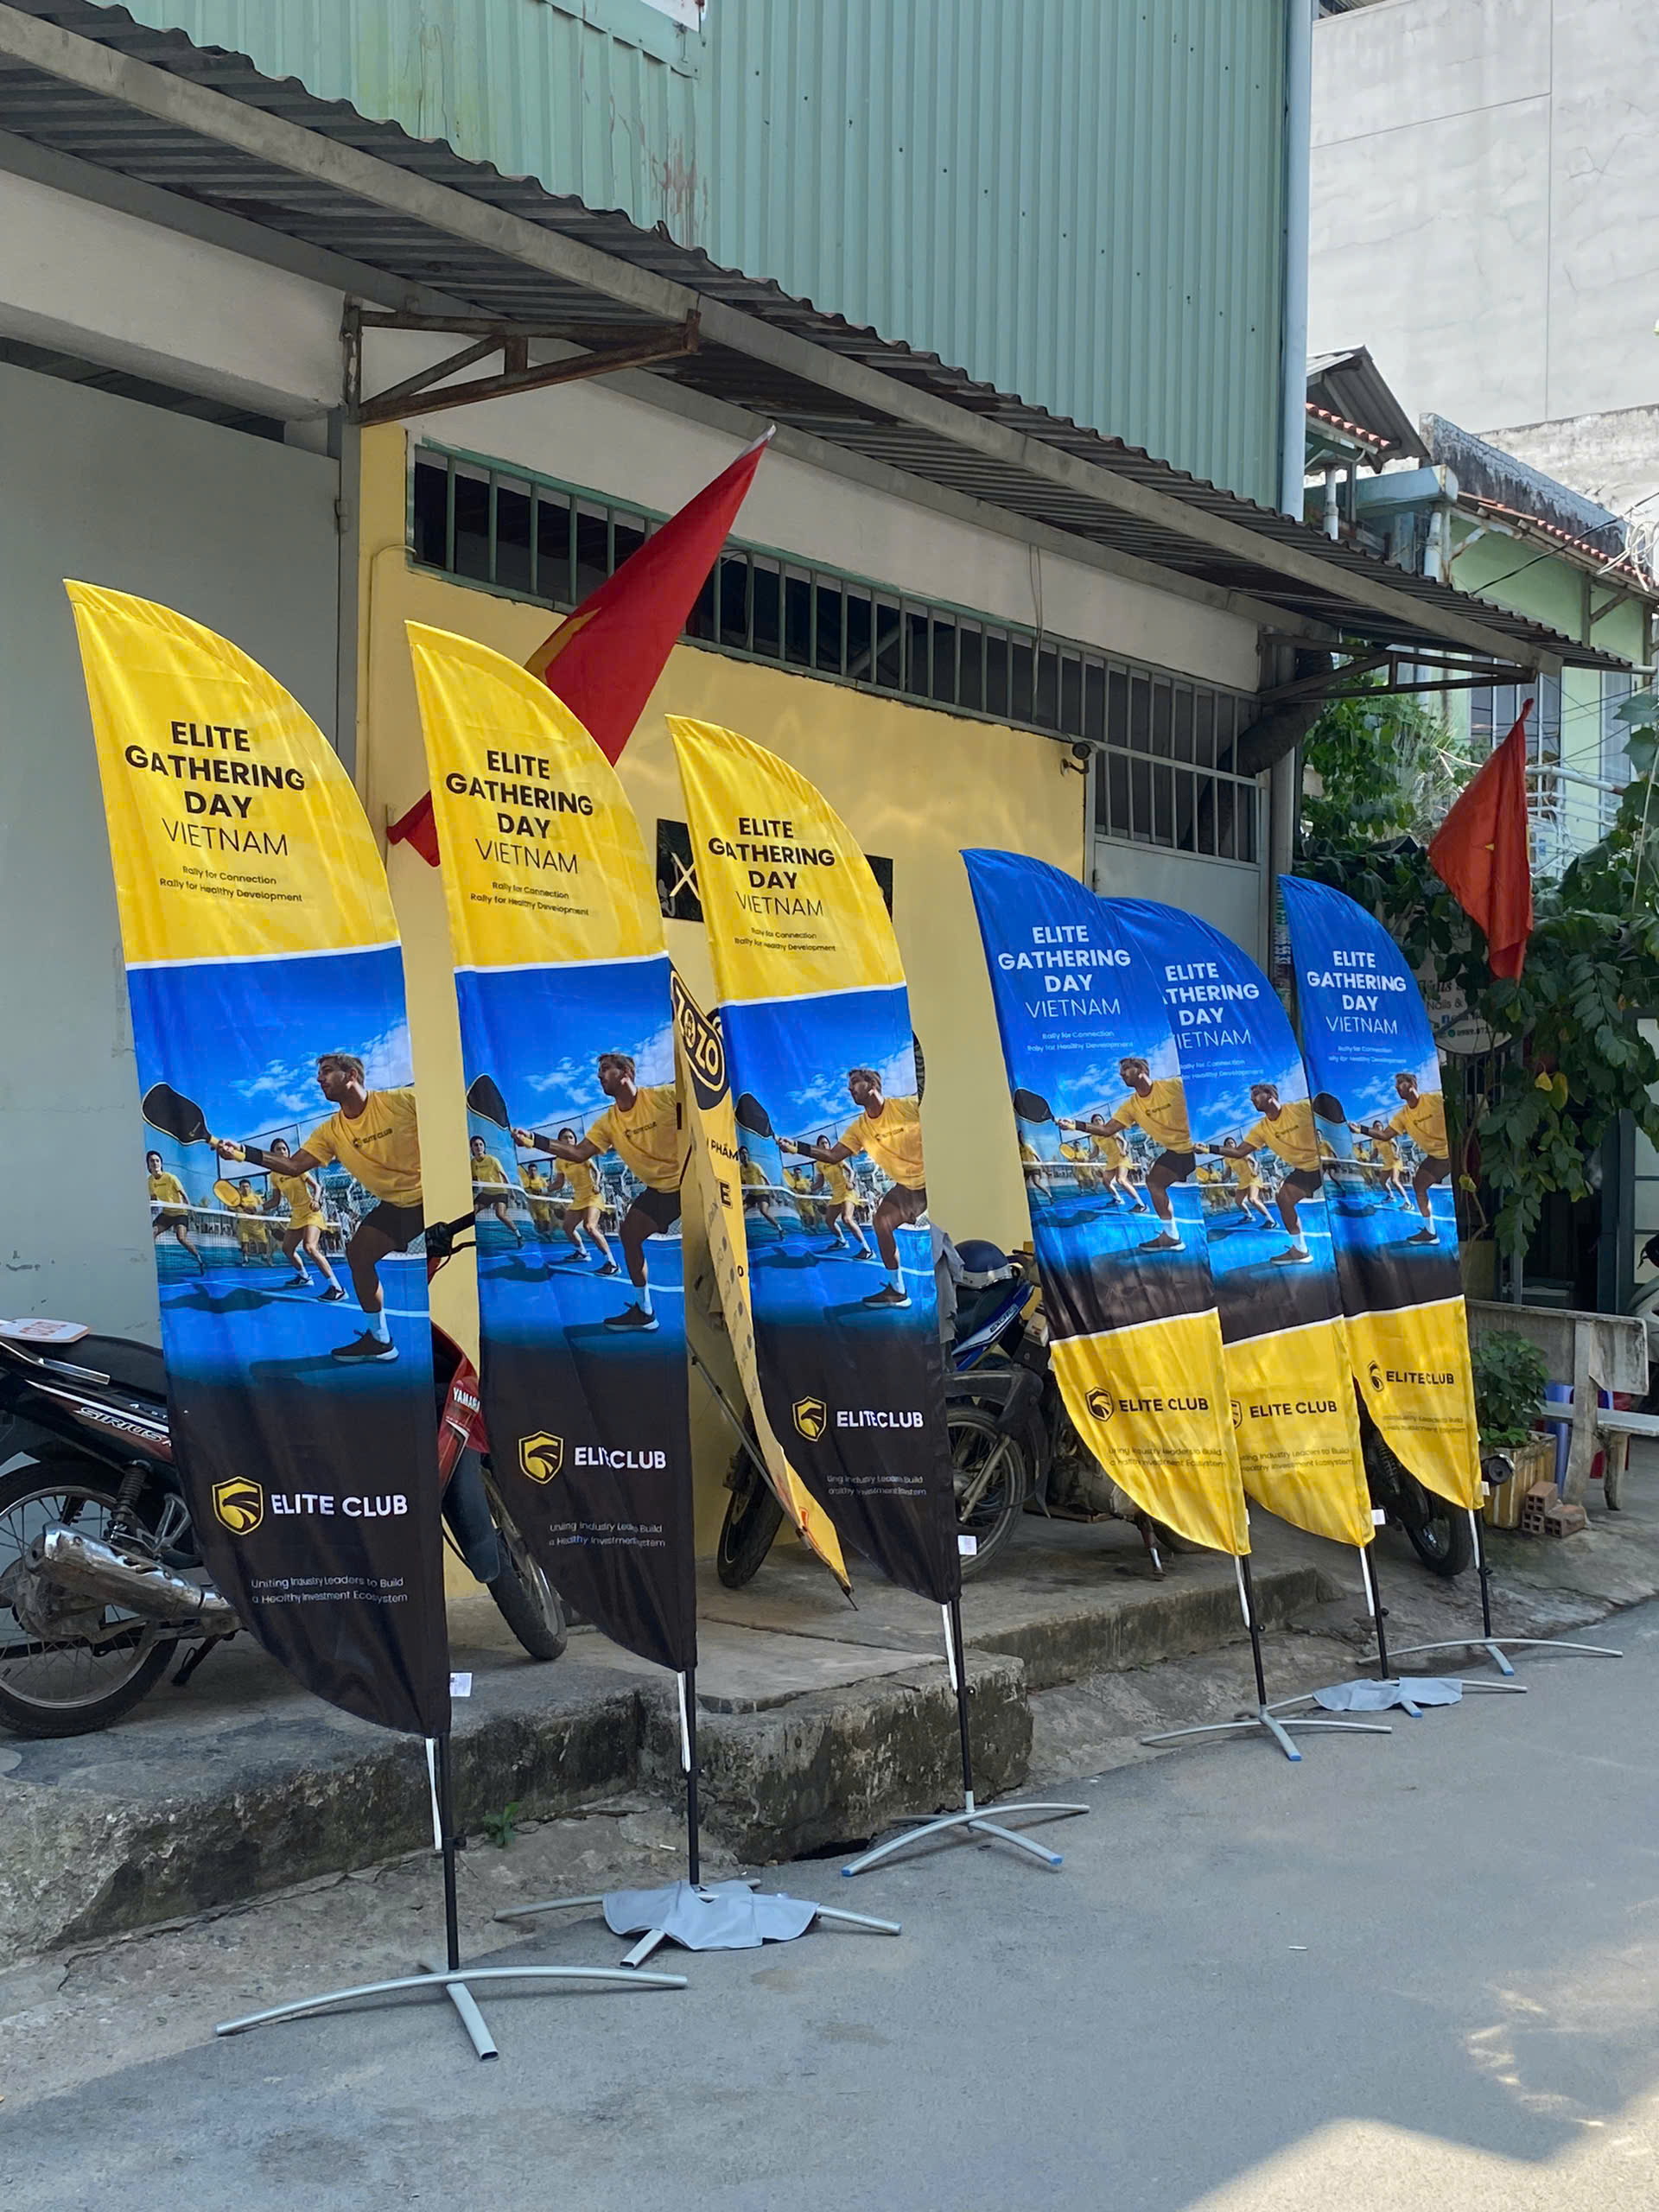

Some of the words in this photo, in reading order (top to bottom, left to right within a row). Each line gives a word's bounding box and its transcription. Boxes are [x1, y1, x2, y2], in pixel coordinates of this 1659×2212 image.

[171, 721, 251, 753] ELITE
[124, 745, 305, 791] GATHERING
[486, 749, 550, 780] ELITE
[184, 791, 252, 819] DAY
[445, 773, 594, 816] GATHERING
[497, 812, 551, 839] DAY
[739, 817, 794, 839] ELITE
[162, 817, 289, 856] VIETNAM
[475, 838, 578, 874] VIETNAM
[708, 837, 836, 867] GATHERING
[182, 866, 203, 878] Rally
[205, 870, 217, 879] for
[219, 872, 276, 885] Connection
[748, 870, 798, 889] DAY
[160, 878, 184, 890] Rally
[186, 881, 198, 891] for
[200, 886, 234, 899] Healthy
[236, 889, 302, 902] Development
[493, 881, 512, 893] Rally
[524, 887, 569, 899] Connection
[470, 893, 493, 905] Rally
[537, 902, 589, 916] Development
[735, 891, 823, 917] VIETNAM
[1032, 925, 1089, 944] ELITE
[998, 949, 1131, 970] GATHERING
[1333, 950, 1376, 969] ELITE
[1165, 962, 1219, 982] ELITE
[1306, 971, 1407, 992] GATHERING
[1044, 974, 1092, 993] DAY
[1163, 983, 1260, 1005] THERING
[1026, 998, 1121, 1018] VIETNAM
[1342, 995, 1379, 1012] DAY
[1179, 1007, 1224, 1027] DAY
[1325, 1016, 1398, 1035] VIETNAM
[1173, 1029, 1252, 1050] IETNAM
[1386, 1370, 1425, 1384] ELITE
[1426, 1372, 1454, 1384] CLUB
[1119, 1398, 1163, 1412] ELITE
[1168, 1397, 1209, 1411] CLUB
[1249, 1402, 1293, 1419] ELITE
[1296, 1400, 1338, 1415] CLUB
[73, 1407, 162, 1442] SIRIUS
[876, 1411, 924, 1428] CLUB
[609, 1450, 667, 1469] CLUB
[270, 1494, 334, 1516] ELITE
[341, 1494, 408, 1517] CLUB
[251, 1578, 289, 1590] Uniting
[290, 1576, 323, 1587] Industry
[324, 1575, 365, 1586] Leaders
[366, 1578, 378, 1587] to
[379, 1577, 404, 1588] Build
[251, 1595, 259, 1604] a
[261, 1592, 302, 1605] Healthy
[302, 1591, 350, 1602] Investment
